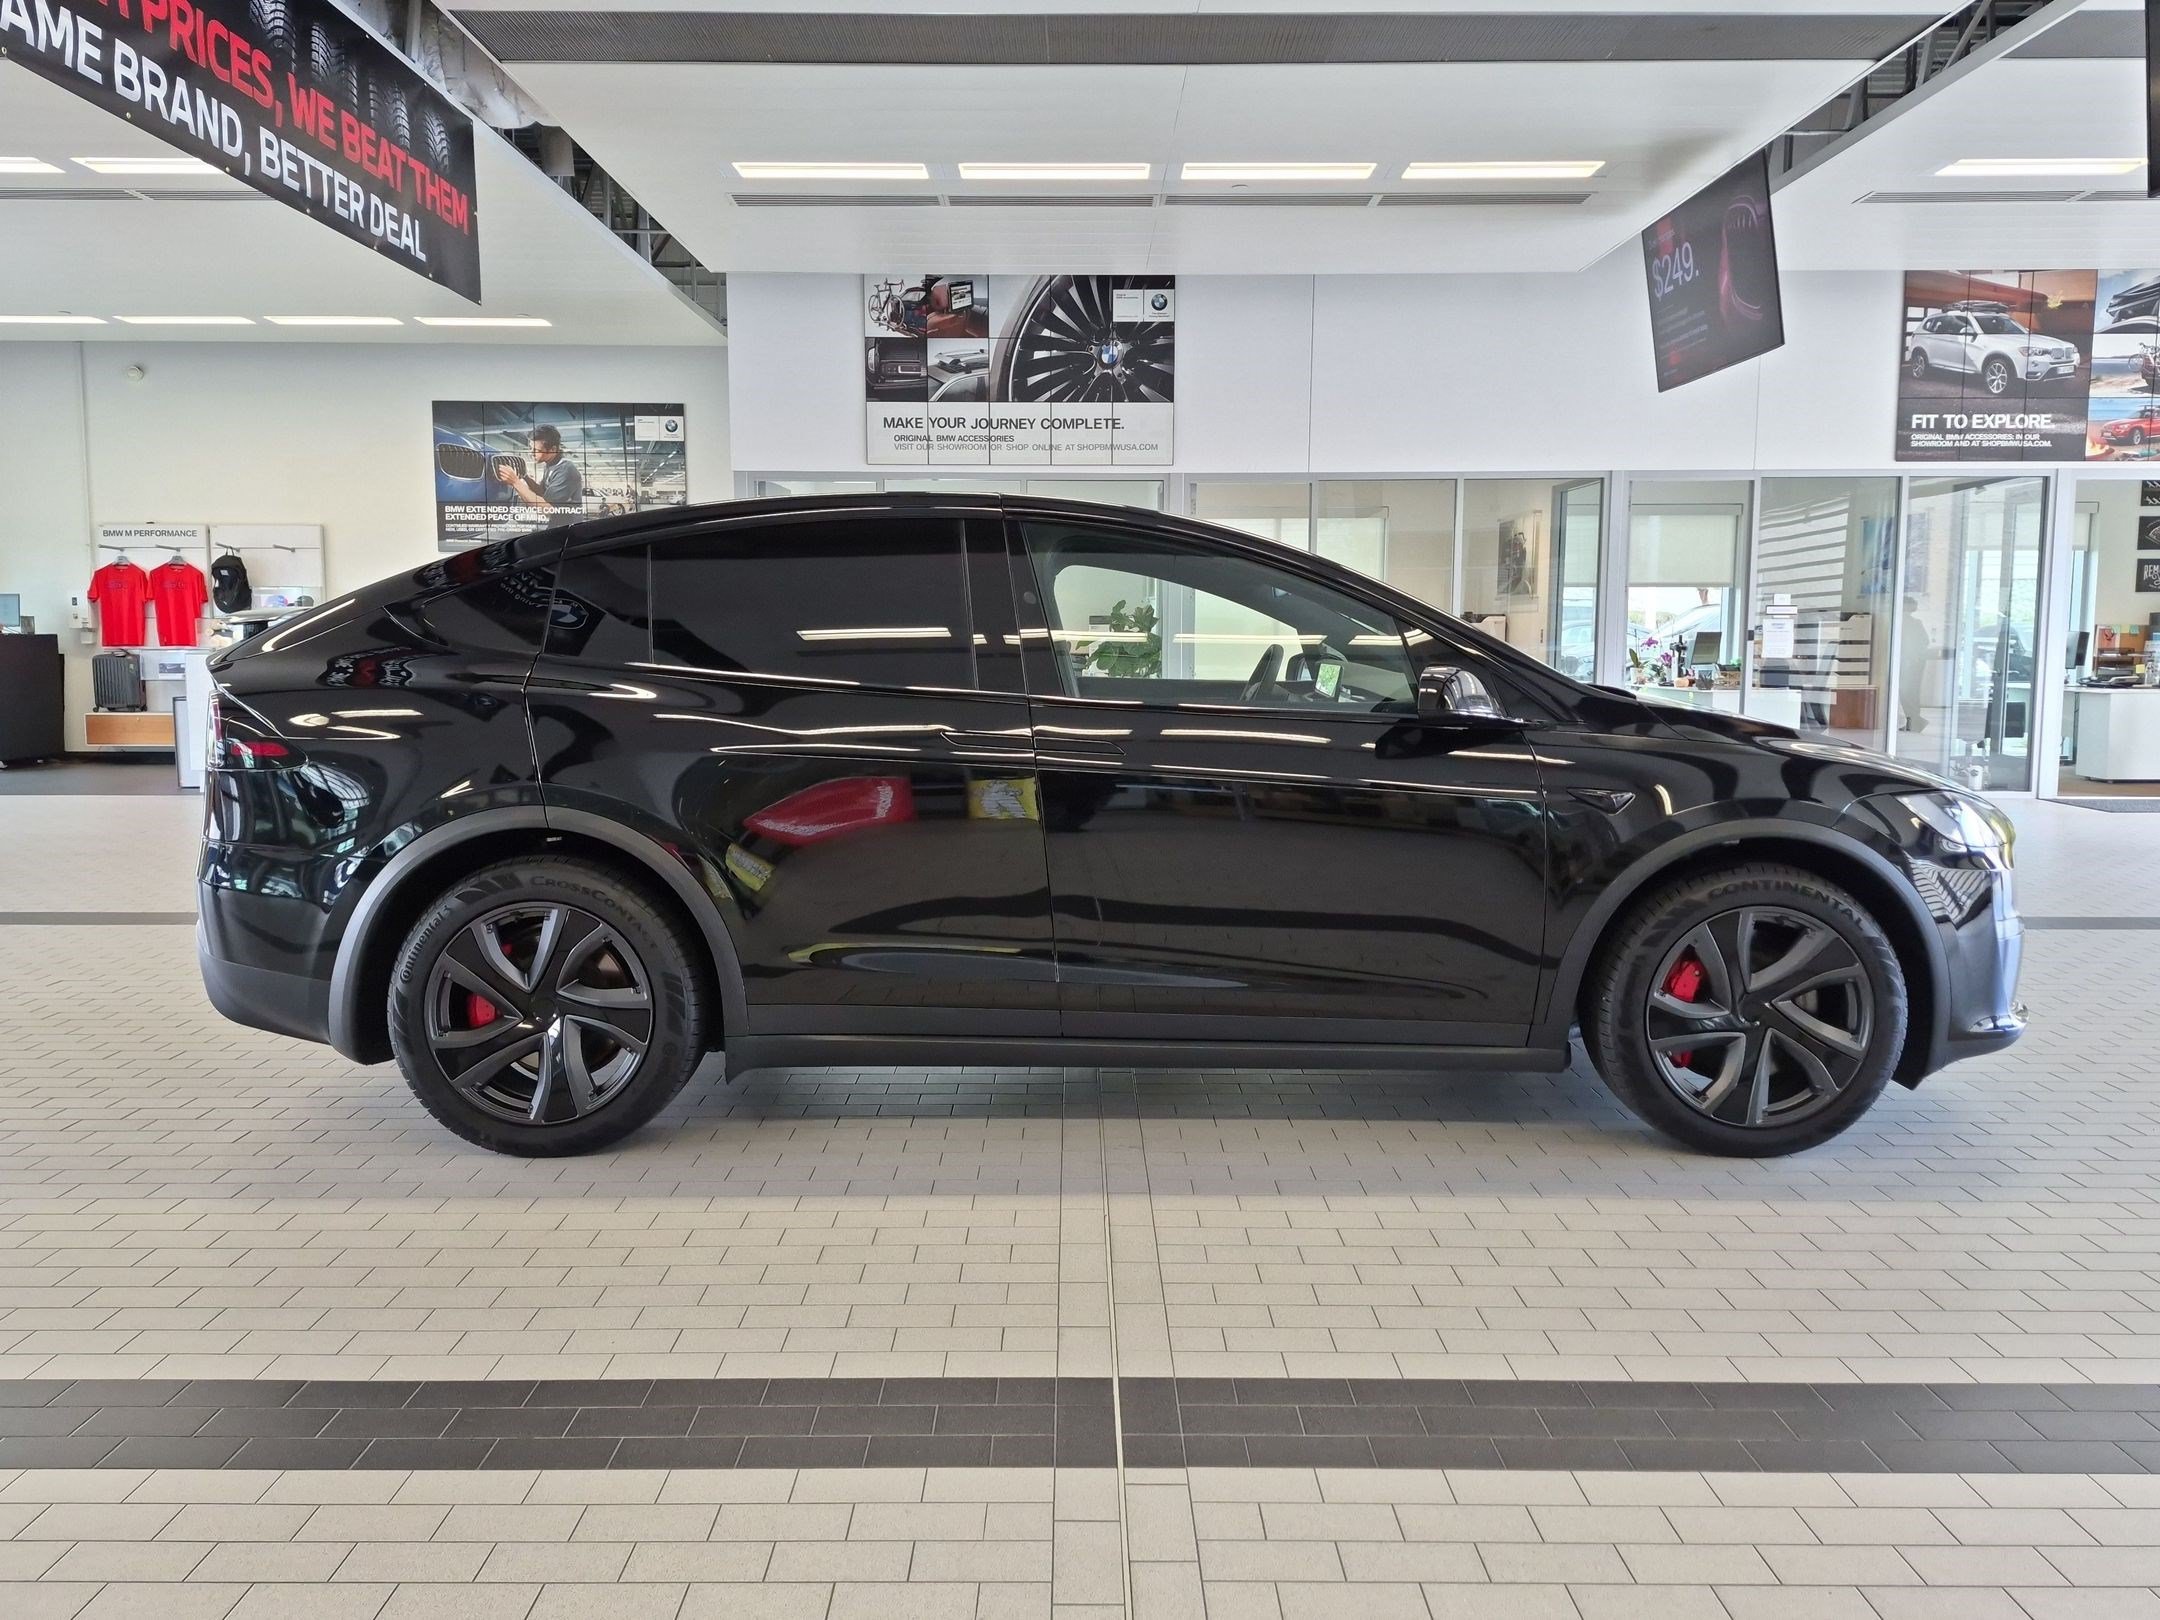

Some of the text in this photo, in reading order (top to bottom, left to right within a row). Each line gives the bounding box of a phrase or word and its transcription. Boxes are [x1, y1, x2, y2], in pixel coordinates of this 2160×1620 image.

[141, 0, 469, 236] PRICES, WE BEAT THEM
[114, 38, 250, 177] BRAND,
[259, 126, 365, 230] BETTER
[369, 199, 426, 262] DEAL
[1652, 241, 1699, 302] $249.
[883, 417, 1125, 430] MAKE YOUR JOURNEY COMPLETE.
[1911, 414, 2055, 429] FIT TO EXPLORE.
[893, 434, 933, 442] ORIGINAL
[894, 443, 1159, 451] VISIT OUR SHOWROOM OR SHOP ONLINE AT SHOPBMWUSA.COM
[445, 505, 465, 513] BMW
[466, 505, 509, 513] EXTENDED
[509, 506, 542, 514] SERVICE
[514, 513, 526, 521] OF
[103, 529, 197, 537] BMW M PERFORMANCE
